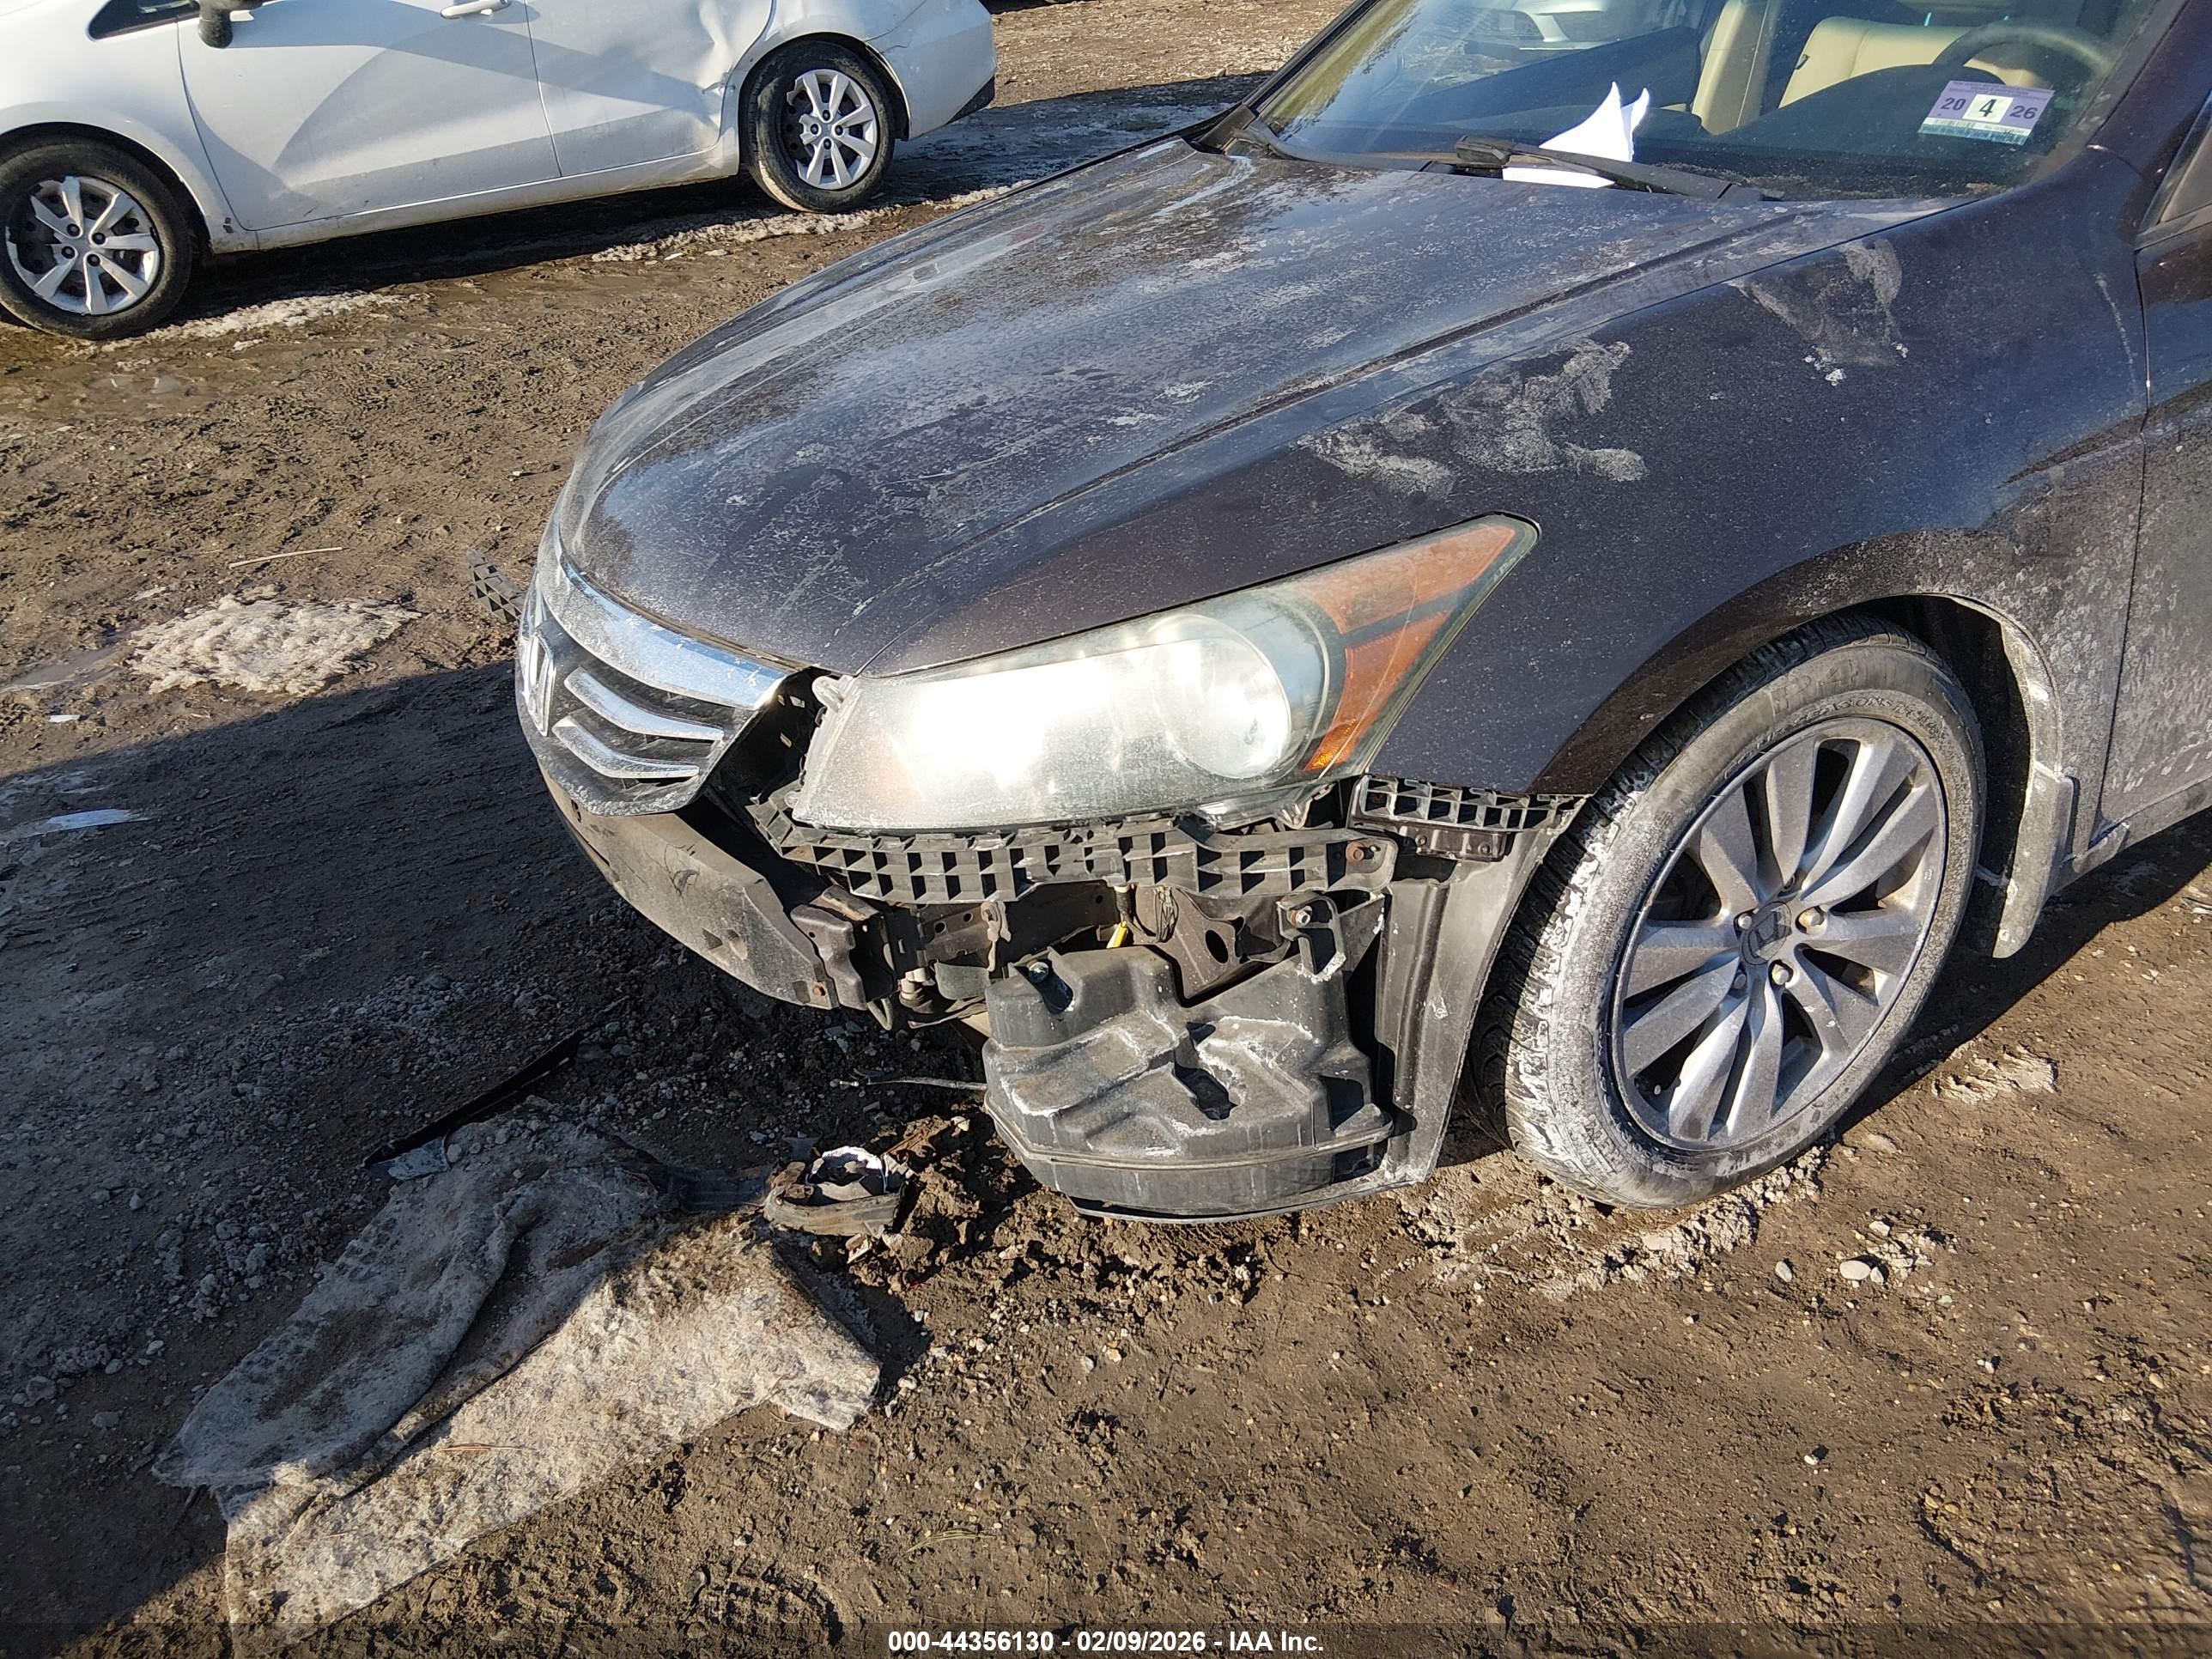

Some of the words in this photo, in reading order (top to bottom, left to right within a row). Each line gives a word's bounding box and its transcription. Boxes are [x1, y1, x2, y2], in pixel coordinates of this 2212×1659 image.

[1941, 98, 1966, 111] 20
[1979, 99, 1996, 117] 4
[2009, 106, 2038, 119] 26
